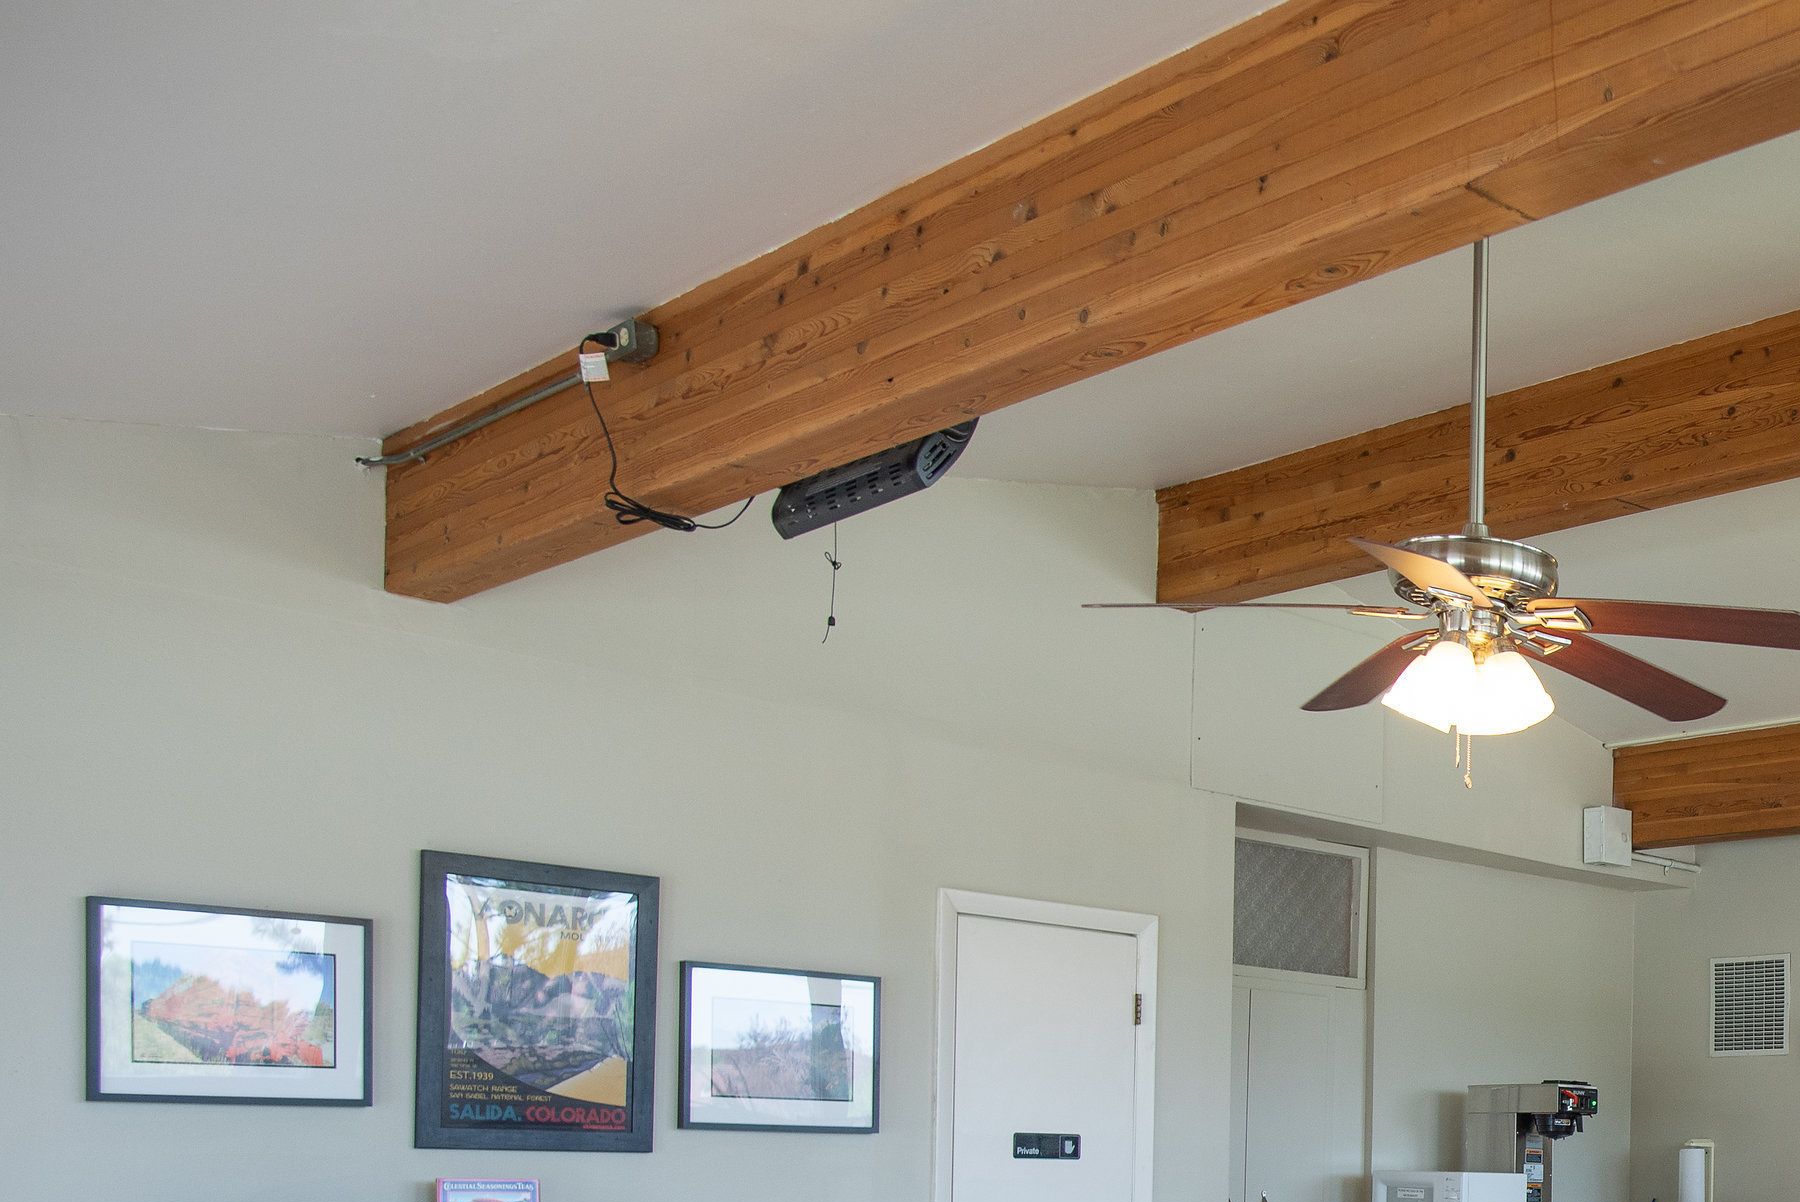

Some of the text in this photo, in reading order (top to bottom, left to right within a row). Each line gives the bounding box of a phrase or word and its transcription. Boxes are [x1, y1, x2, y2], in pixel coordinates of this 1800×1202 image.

[449, 1070, 494, 1081] EST.1939
[449, 1083, 517, 1093] SAWATCH RANGE
[449, 1091, 464, 1099] SAN
[465, 1092, 487, 1100] ISABEL
[490, 1093, 524, 1101] NATIONAL
[526, 1105, 626, 1124] COLORADO
[1016, 1146, 1040, 1155] Private
[443, 1181, 534, 1191] CELESTIAL SEASONINGS TEAS
